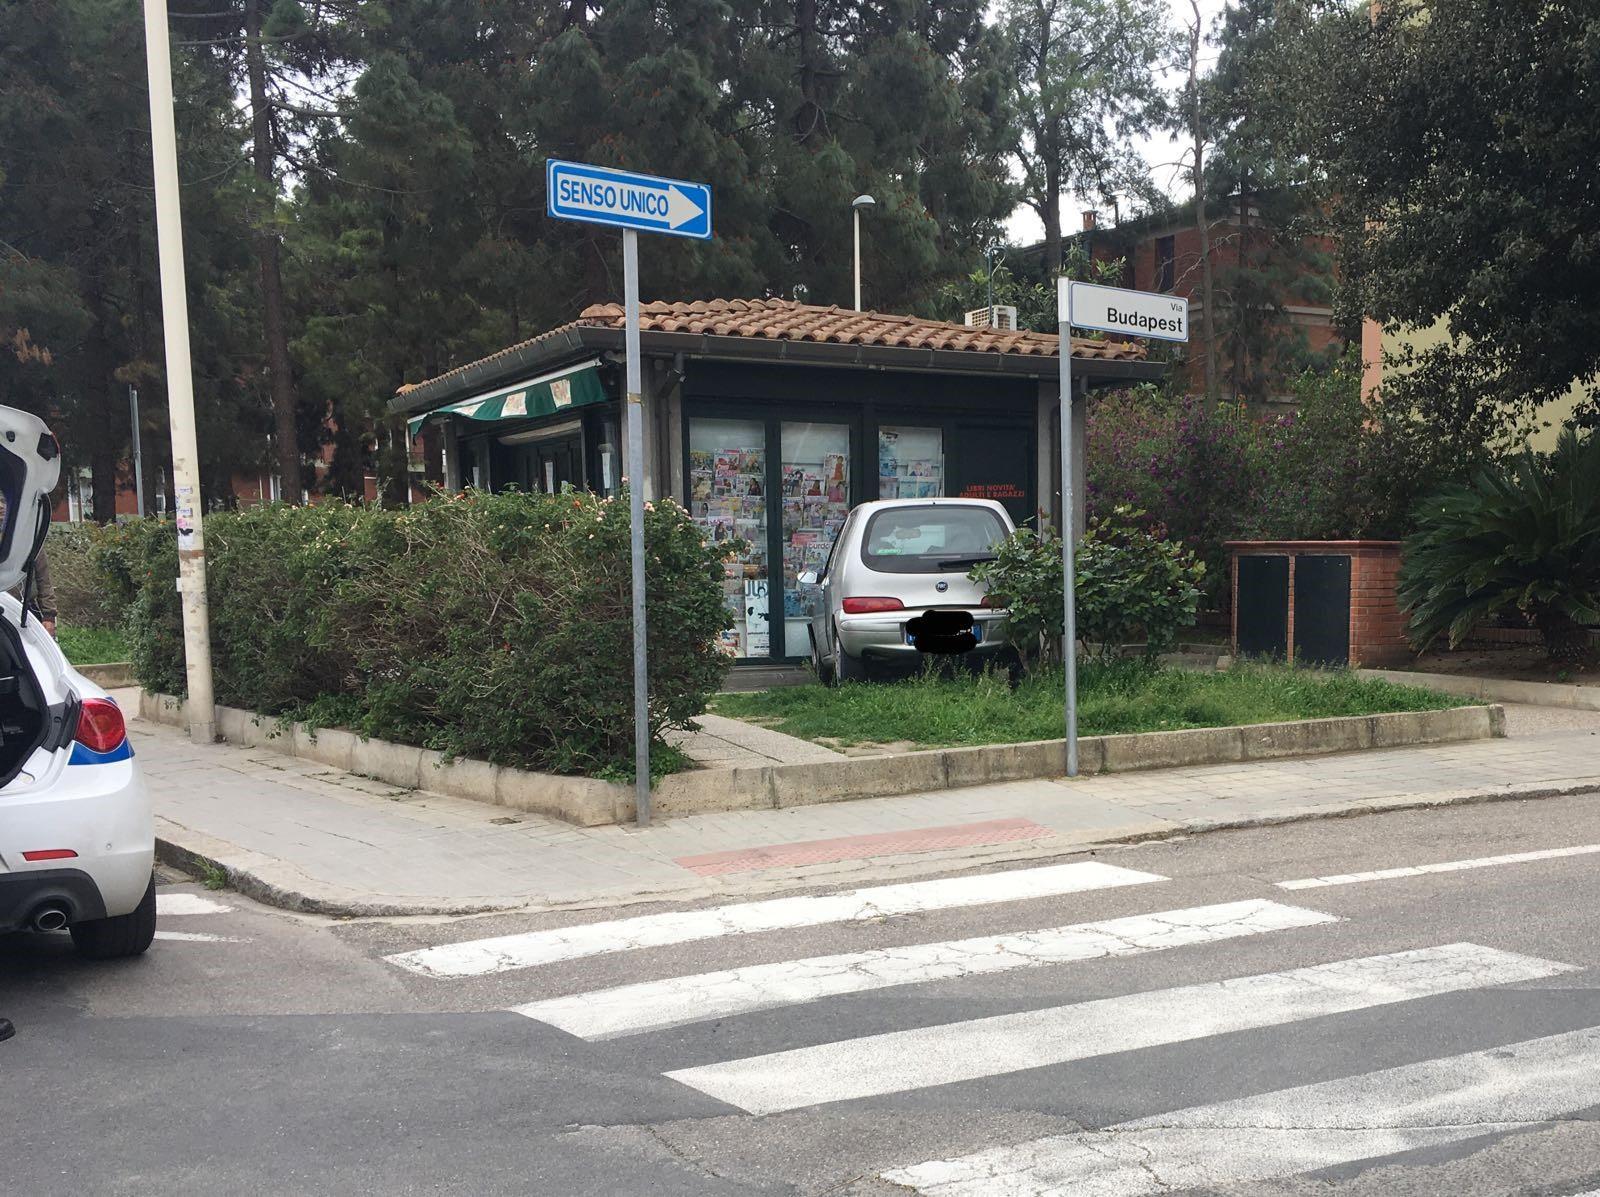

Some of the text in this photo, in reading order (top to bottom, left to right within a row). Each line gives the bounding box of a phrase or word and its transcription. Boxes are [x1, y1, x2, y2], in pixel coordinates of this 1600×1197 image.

[560, 179, 669, 217] SENSO UNICO
[1107, 307, 1183, 332] Budapest
[1170, 302, 1183, 312] Via
